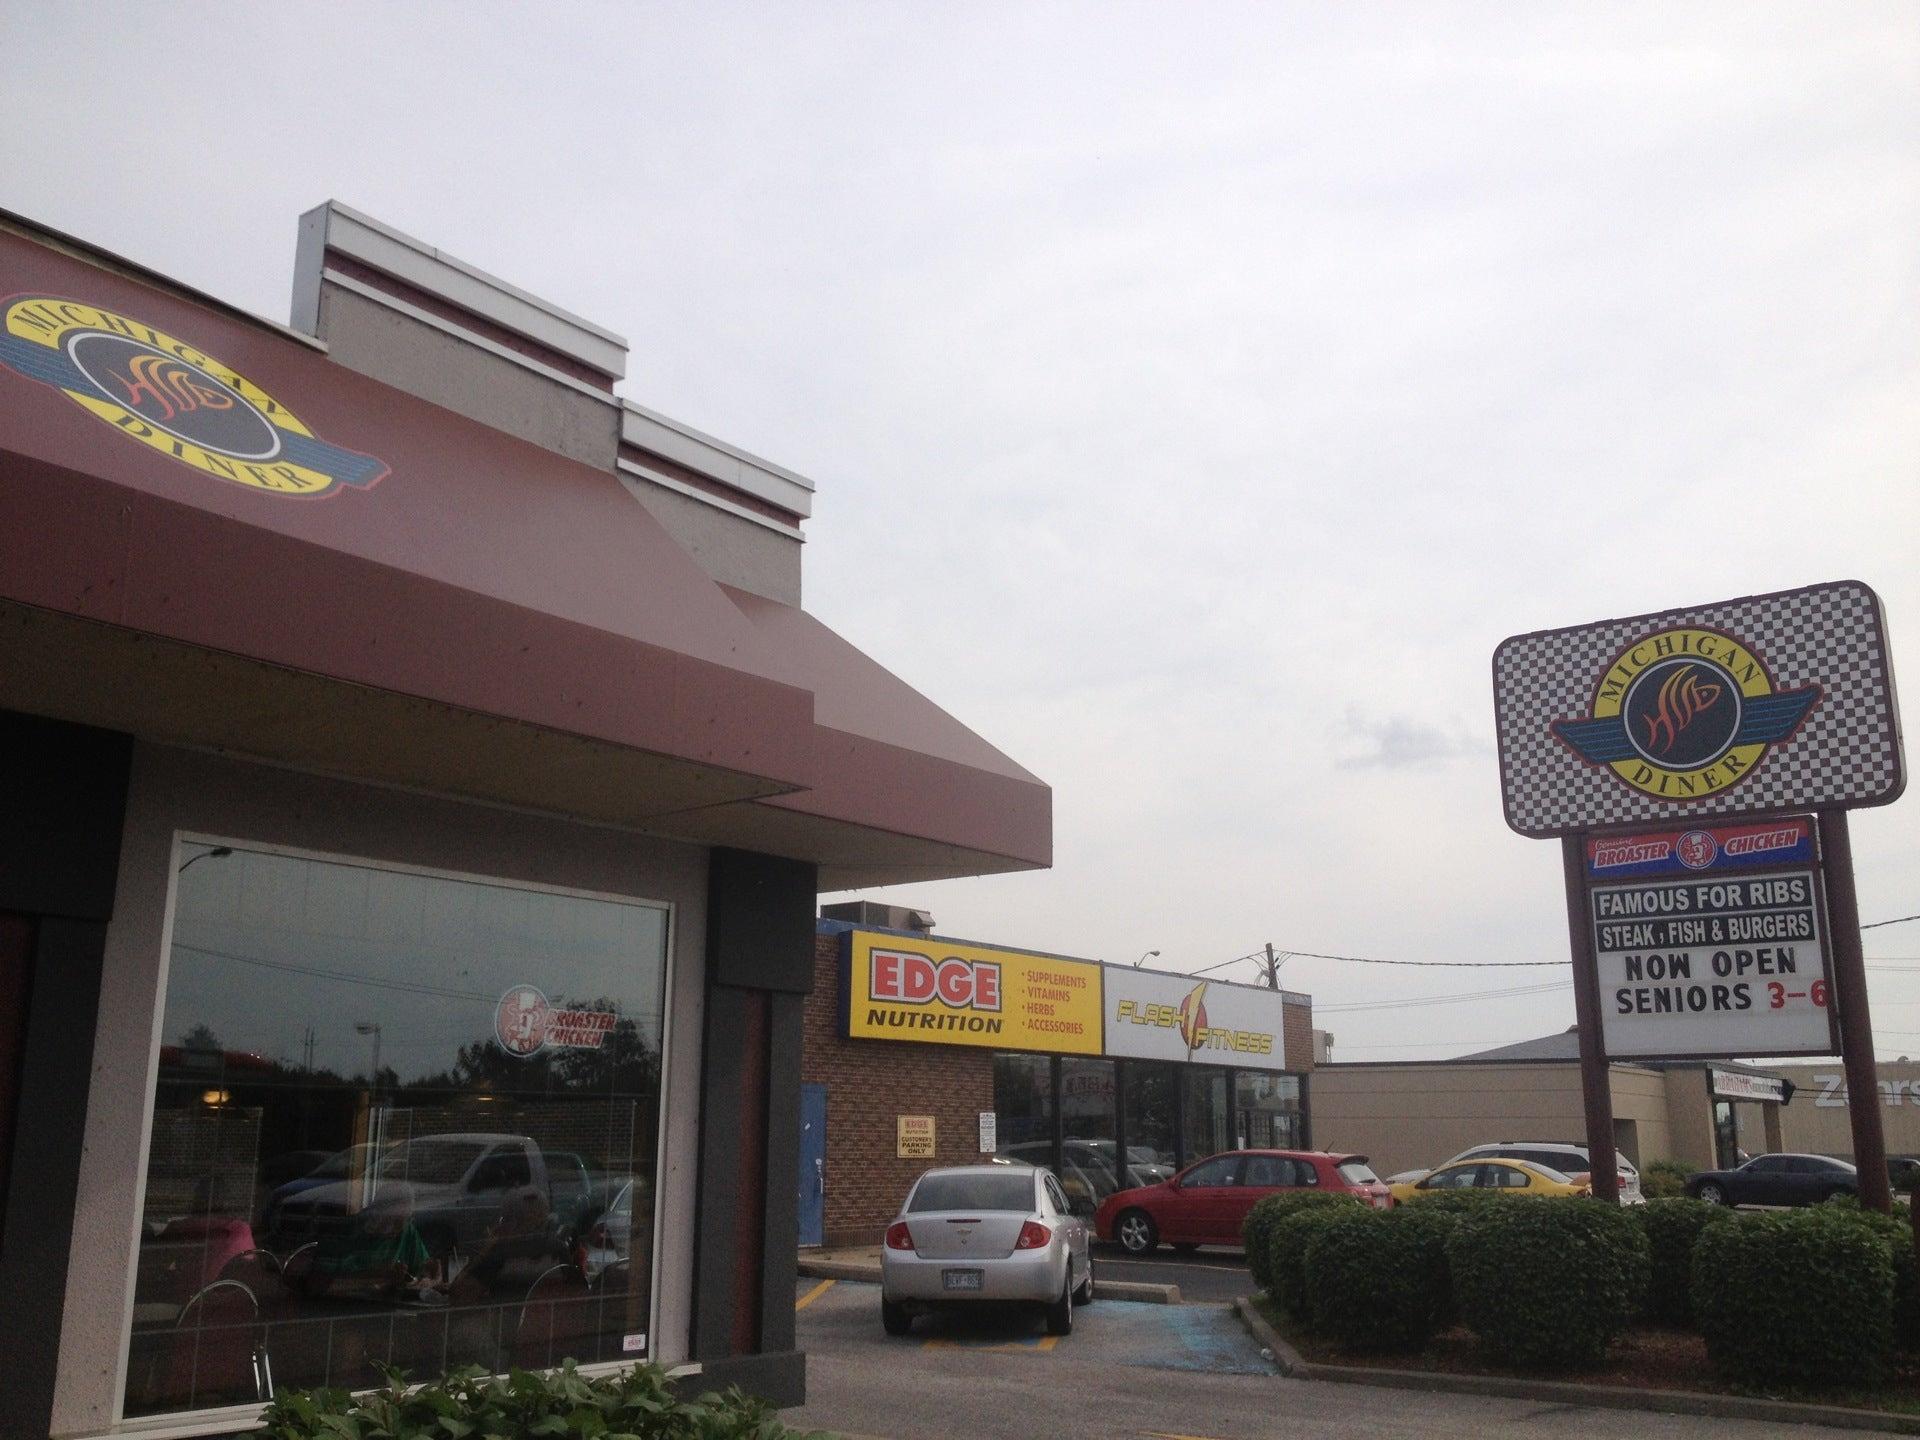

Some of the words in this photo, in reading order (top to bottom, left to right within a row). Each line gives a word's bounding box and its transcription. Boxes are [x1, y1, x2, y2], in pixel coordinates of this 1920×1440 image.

[13, 303, 289, 414] MICHIGAN
[116, 414, 313, 489] DINER
[1602, 634, 1763, 704] MICHIGAN
[1632, 754, 1748, 795] DINER
[1595, 842, 1669, 868] BROASTER
[1724, 829, 1798, 856] CHICKEN
[1599, 887, 1690, 916] FAMOUS
[1696, 884, 1742, 910] FOR
[1750, 879, 1806, 906] RIBS
[1668, 919, 1706, 945] FISH
[1711, 919, 1724, 941] &
[1727, 913, 1810, 941] BURGERS
[871, 949, 1000, 1010] EDGE
[1027, 970, 1087, 989] SUPPLEMENTS
[1625, 952, 1691, 981] NOW
[1712, 947, 1797, 977] OPEN
[1027, 1002, 1055, 1015] HERBS
[1028, 988, 1071, 1002] VITAMINS
[1616, 983, 1752, 1015] SENIORS
[866, 1009, 1003, 1034] NUTRITION
[1028, 1018, 1084, 1034] ACCESSORIES
[1117, 999, 1186, 1029] FLASH
[1195, 1027, 1273, 1054] FITNESS
